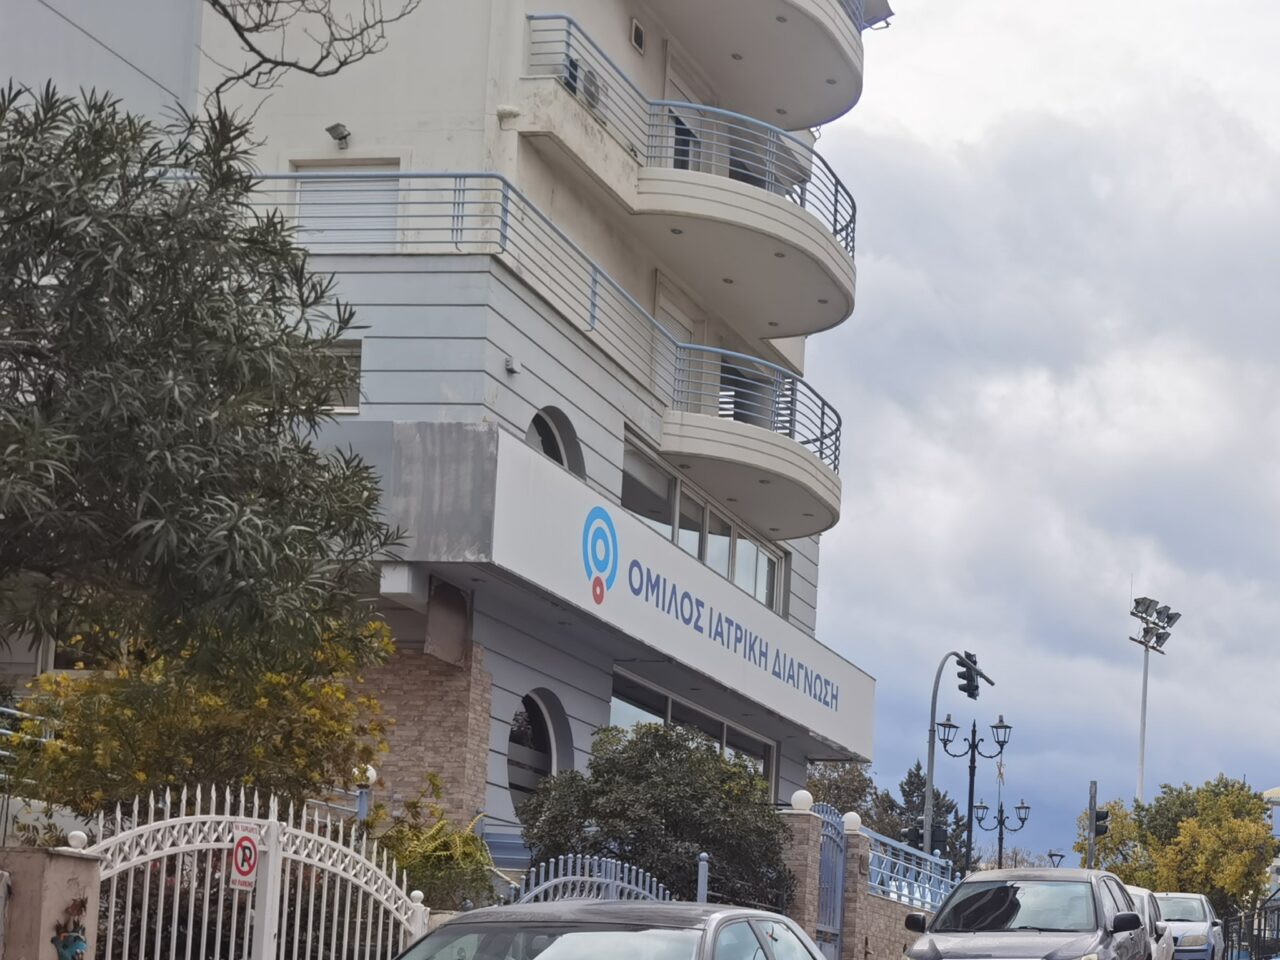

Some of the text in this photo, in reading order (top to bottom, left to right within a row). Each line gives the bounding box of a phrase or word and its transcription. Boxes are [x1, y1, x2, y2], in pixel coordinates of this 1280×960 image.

[628, 559, 839, 712] ΟΜΙΛΟΣ ΙΑΤΡΙΚΗ ΔΙΑΓΝΩΣΗ
